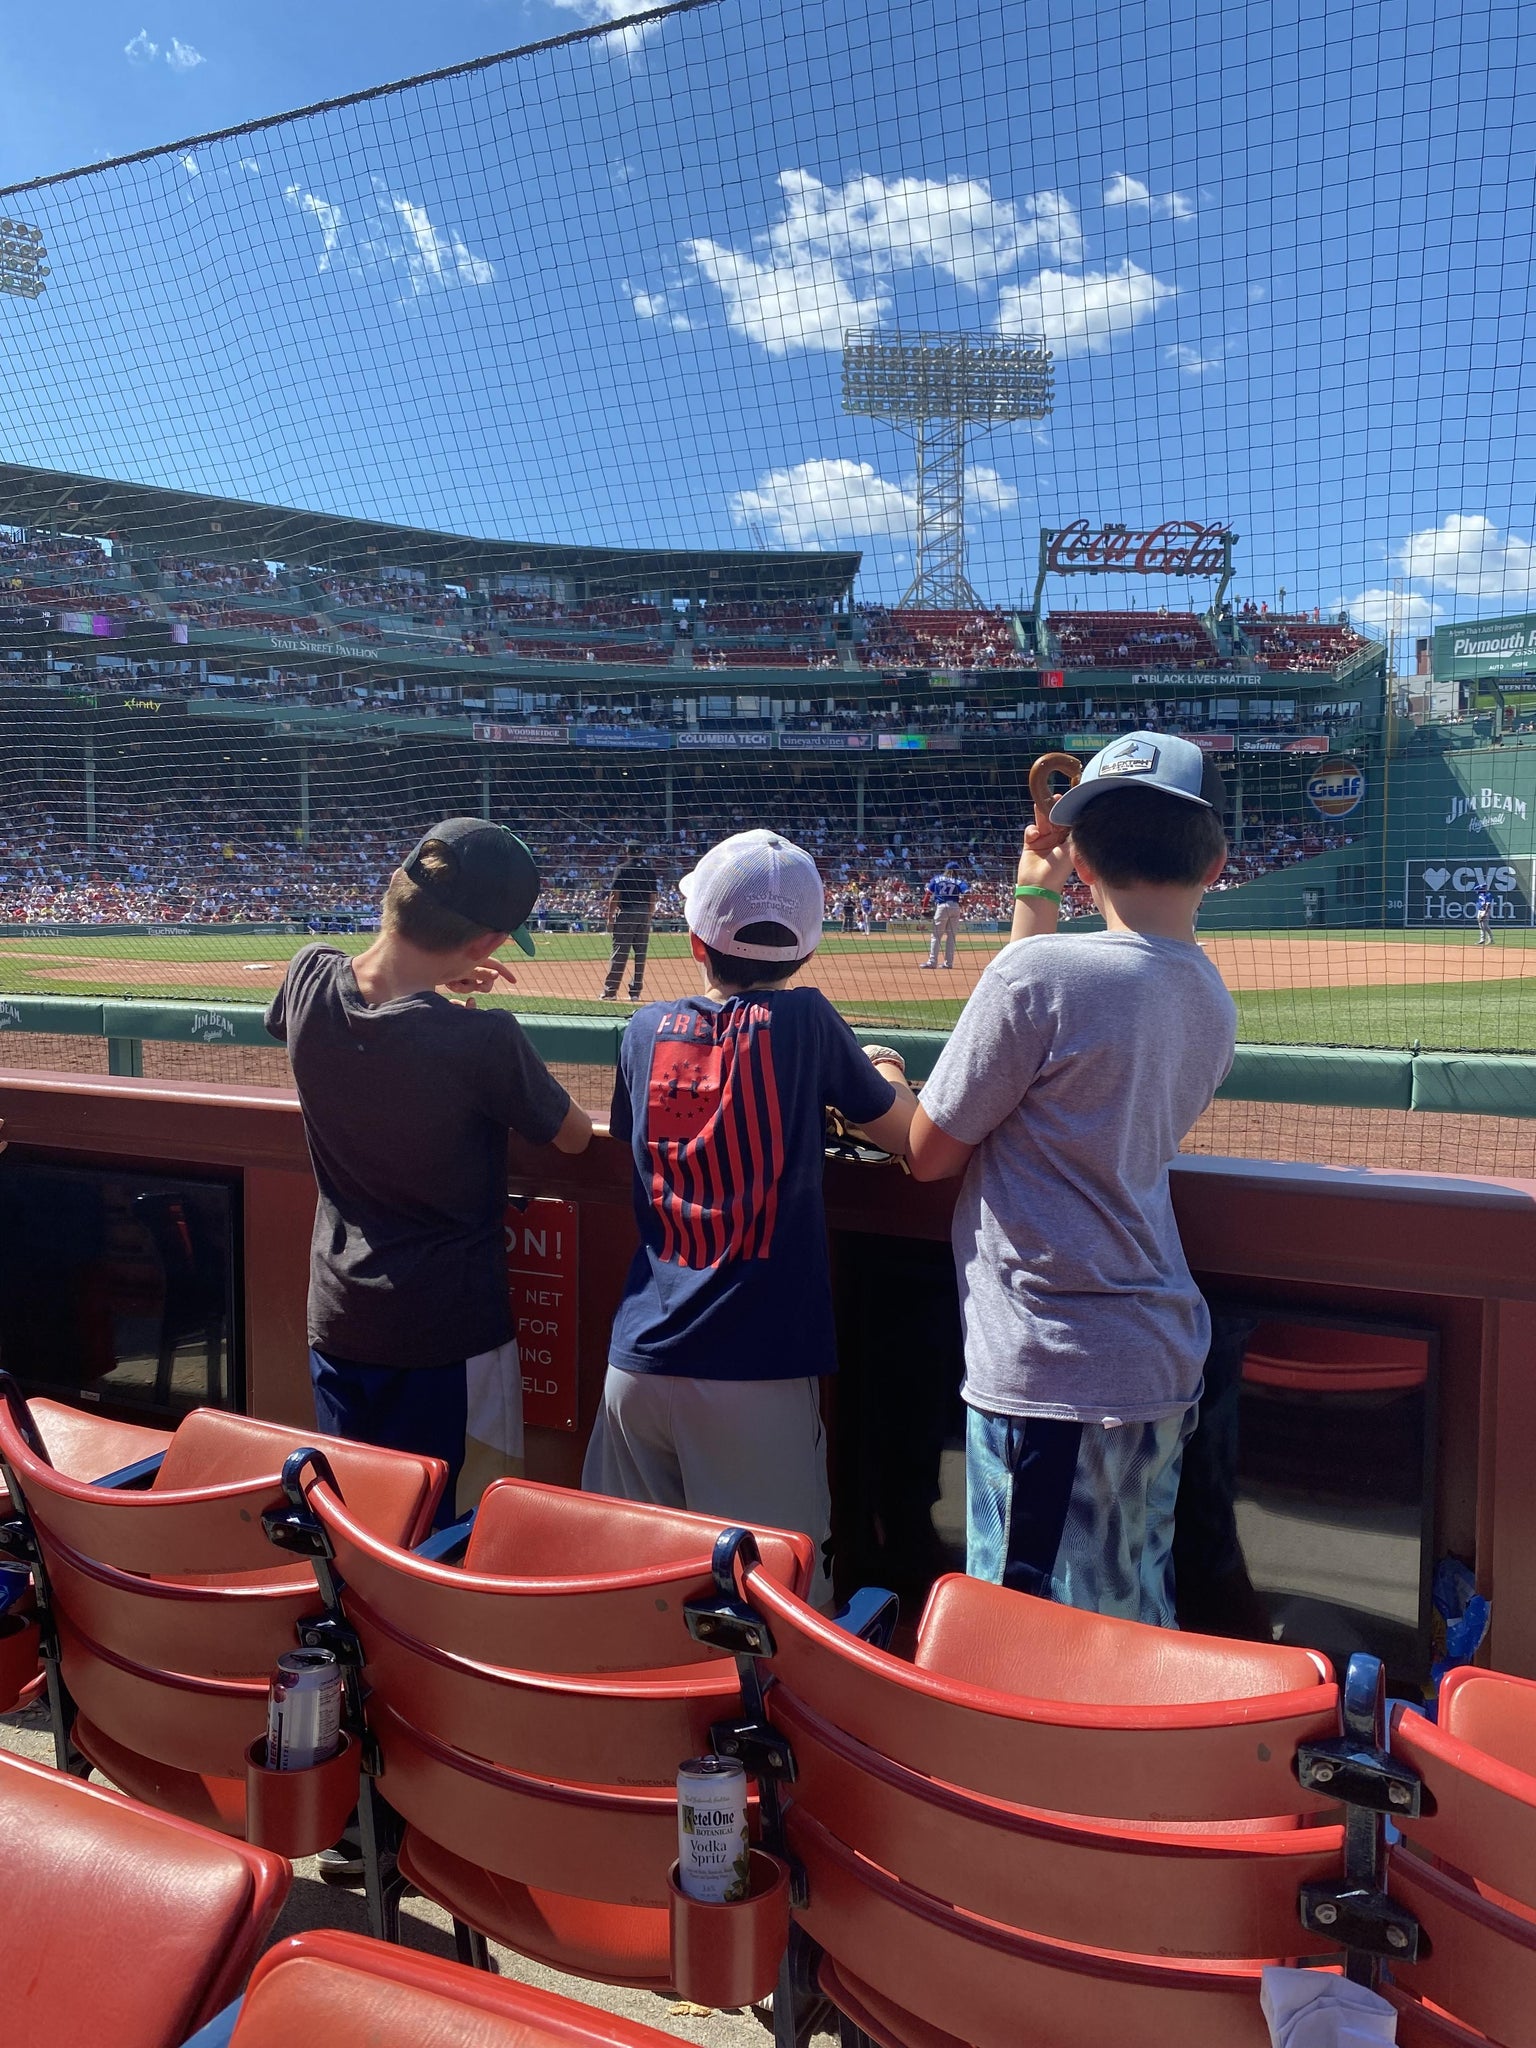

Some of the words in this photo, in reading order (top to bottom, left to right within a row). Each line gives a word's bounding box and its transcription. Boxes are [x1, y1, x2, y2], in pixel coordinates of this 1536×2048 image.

[1150, 674, 1185, 684] BLACK
[1187, 674, 1217, 684] LIVES
[1220, 675, 1261, 685] MATTER
[124, 697, 161, 713] xfinity
[507, 728, 560, 737] WOODBRIDGE
[679, 734, 737, 744] COLUMBIA
[738, 734, 767, 744] TECH
[783, 736, 821, 746] vineyard
[1309, 776, 1360, 797] Gulf
[1446, 796, 1477, 824] JIM
[1481, 788, 1528, 821] BEAM
[1452, 866, 1517, 892] CVS
[1387, 900, 1403, 909] 310
[1424, 895, 1516, 919] Heath
[22, 929, 59, 937] DASANI
[191, 1014, 208, 1034] JIM
[209, 1010, 236, 1037] BEAM
[525, 1289, 563, 1308] NET
[518, 1317, 559, 1337] FOR
[712, 1810, 735, 1826] One
[690, 1839, 727, 1852] Vodka
[691, 1852, 727, 1867] Spritz
